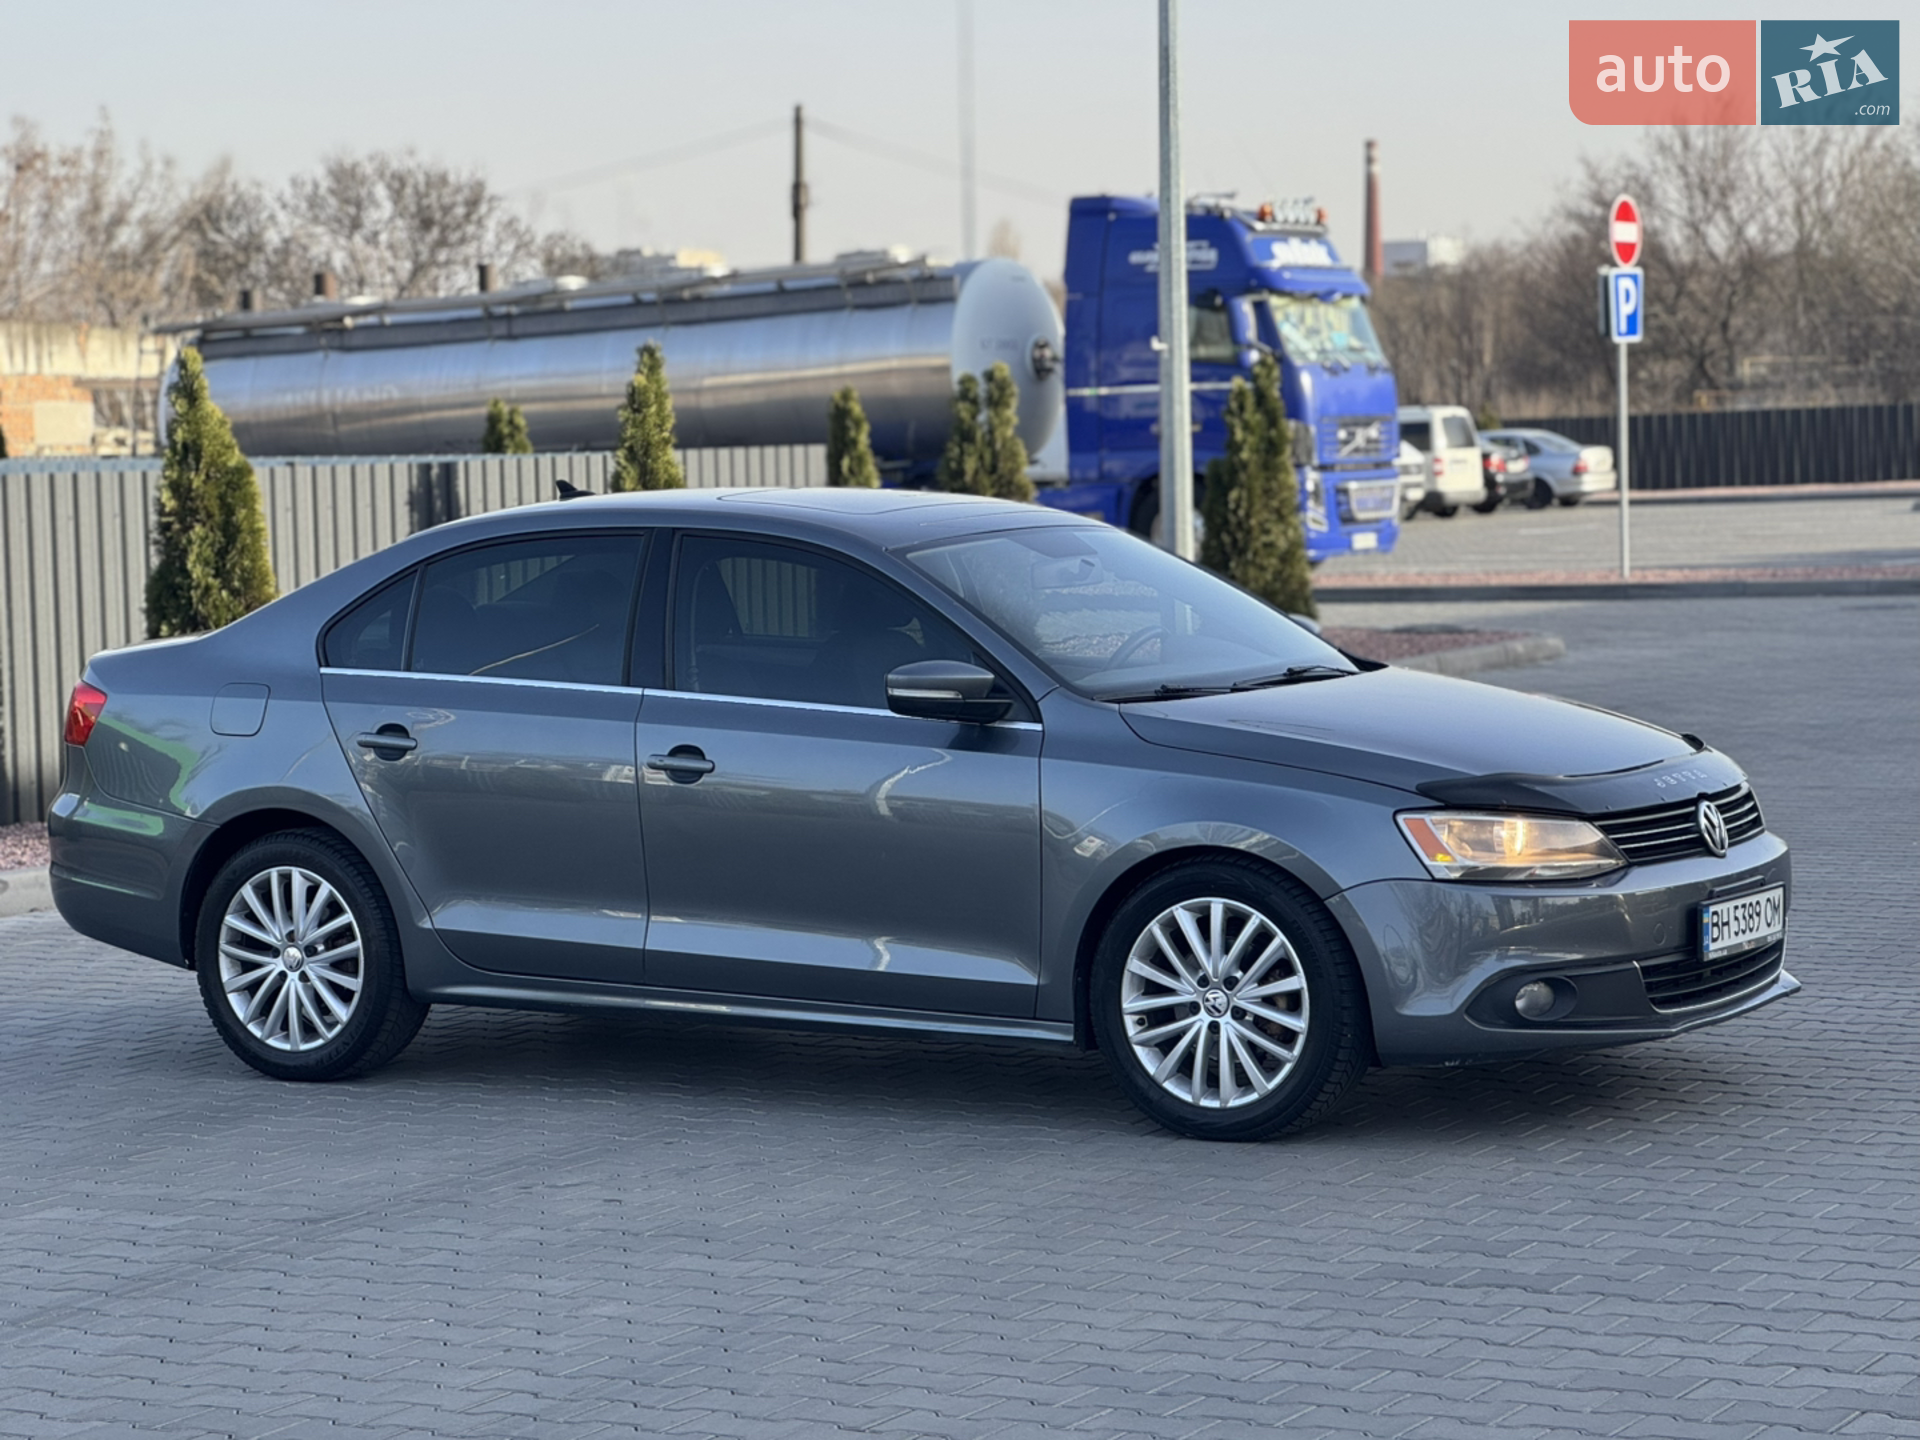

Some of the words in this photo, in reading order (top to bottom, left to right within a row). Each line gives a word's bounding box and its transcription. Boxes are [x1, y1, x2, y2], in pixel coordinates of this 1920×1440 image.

[1618, 277, 1637, 333] P
[1711, 908, 1731, 943] BH
[1733, 900, 1761, 936] 5389
[1765, 894, 1782, 928] OM
